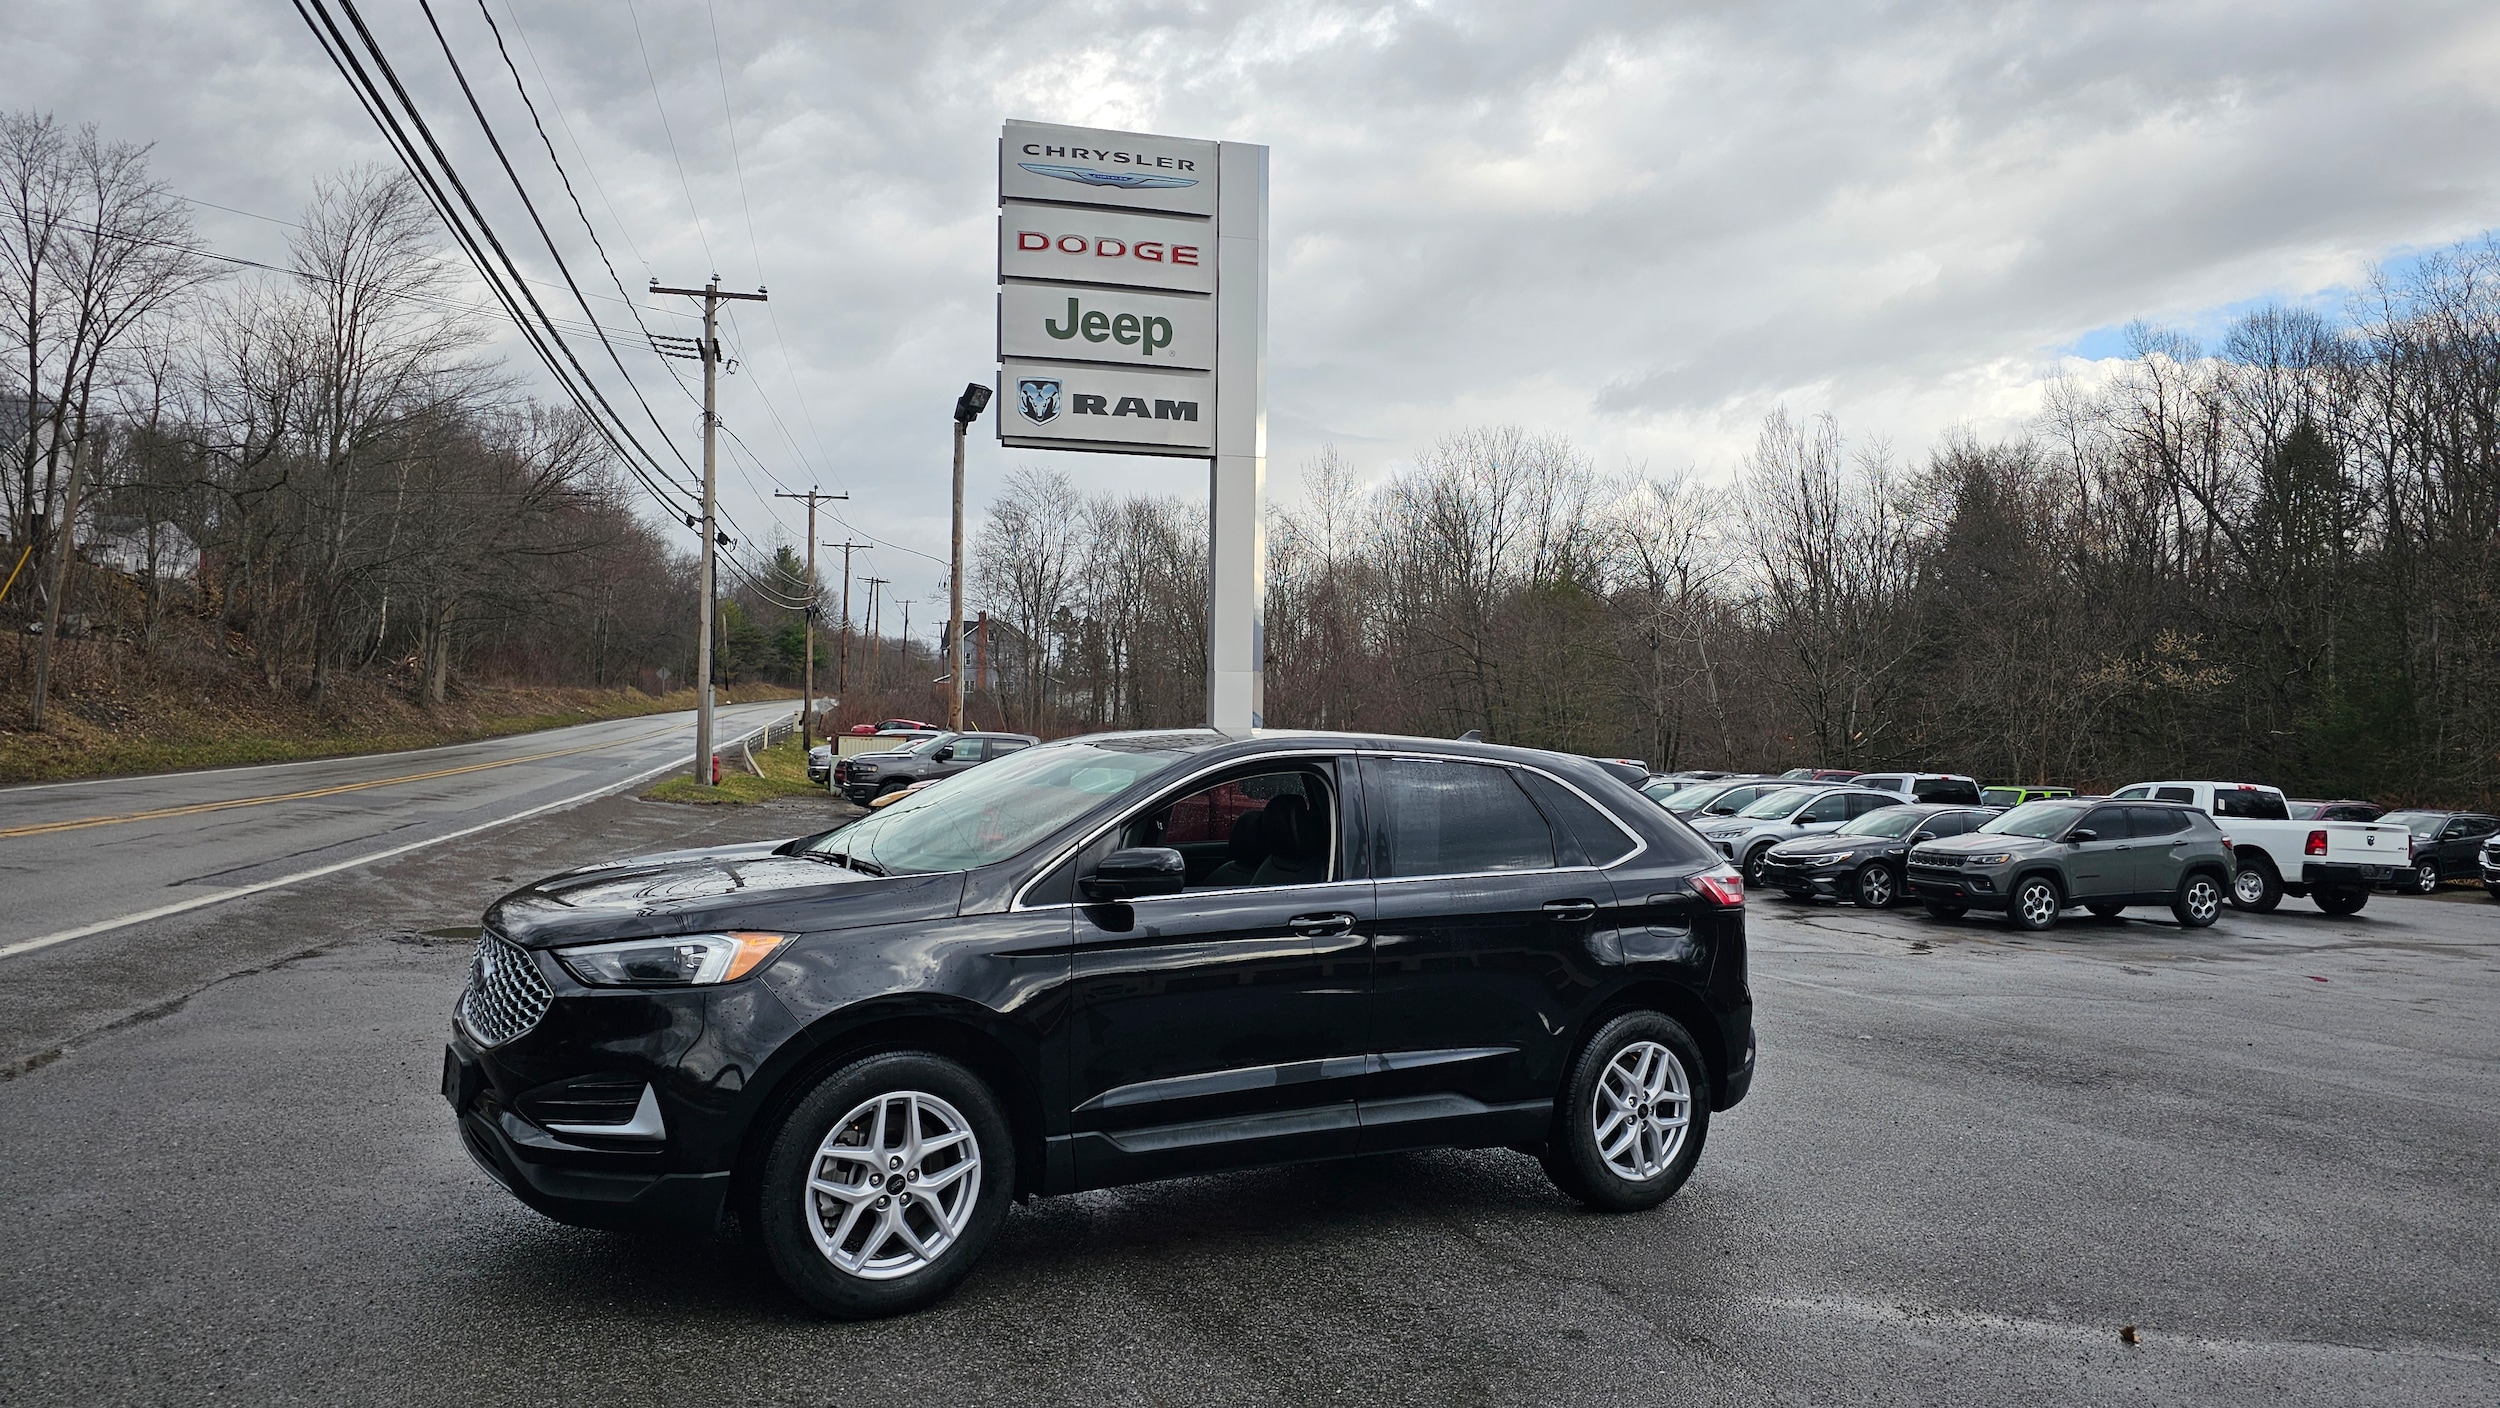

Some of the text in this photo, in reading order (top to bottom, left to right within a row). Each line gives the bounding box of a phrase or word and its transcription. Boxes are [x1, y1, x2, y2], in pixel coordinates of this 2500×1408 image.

[1022, 144, 1195, 171] CHRYSLER
[1018, 231, 1199, 267] DODGE
[1045, 297, 1173, 356] Jeep
[1072, 393, 1199, 422] RAM
